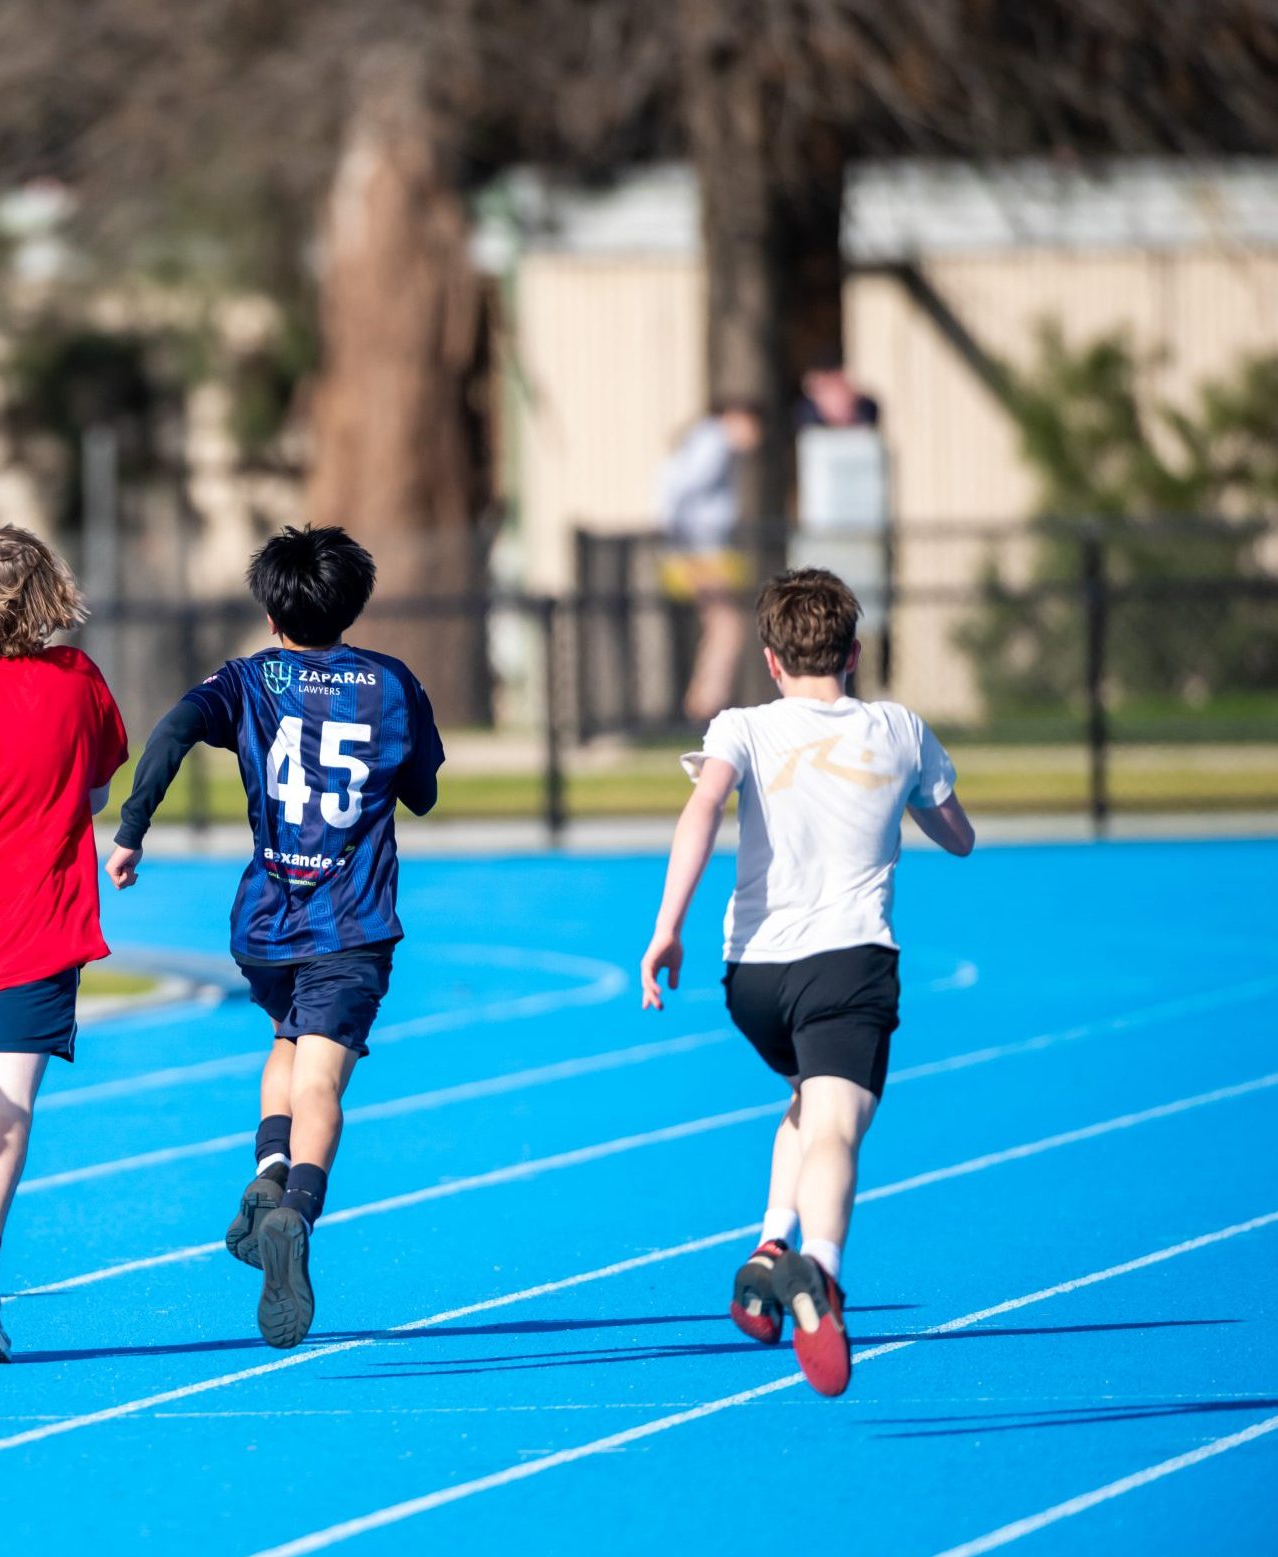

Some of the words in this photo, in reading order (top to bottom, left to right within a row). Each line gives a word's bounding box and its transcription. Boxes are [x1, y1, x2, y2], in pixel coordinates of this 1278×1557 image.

[298, 670, 376, 686] ZAPARAS
[298, 685, 341, 696] LAWYERS
[266, 715, 372, 829] 45
